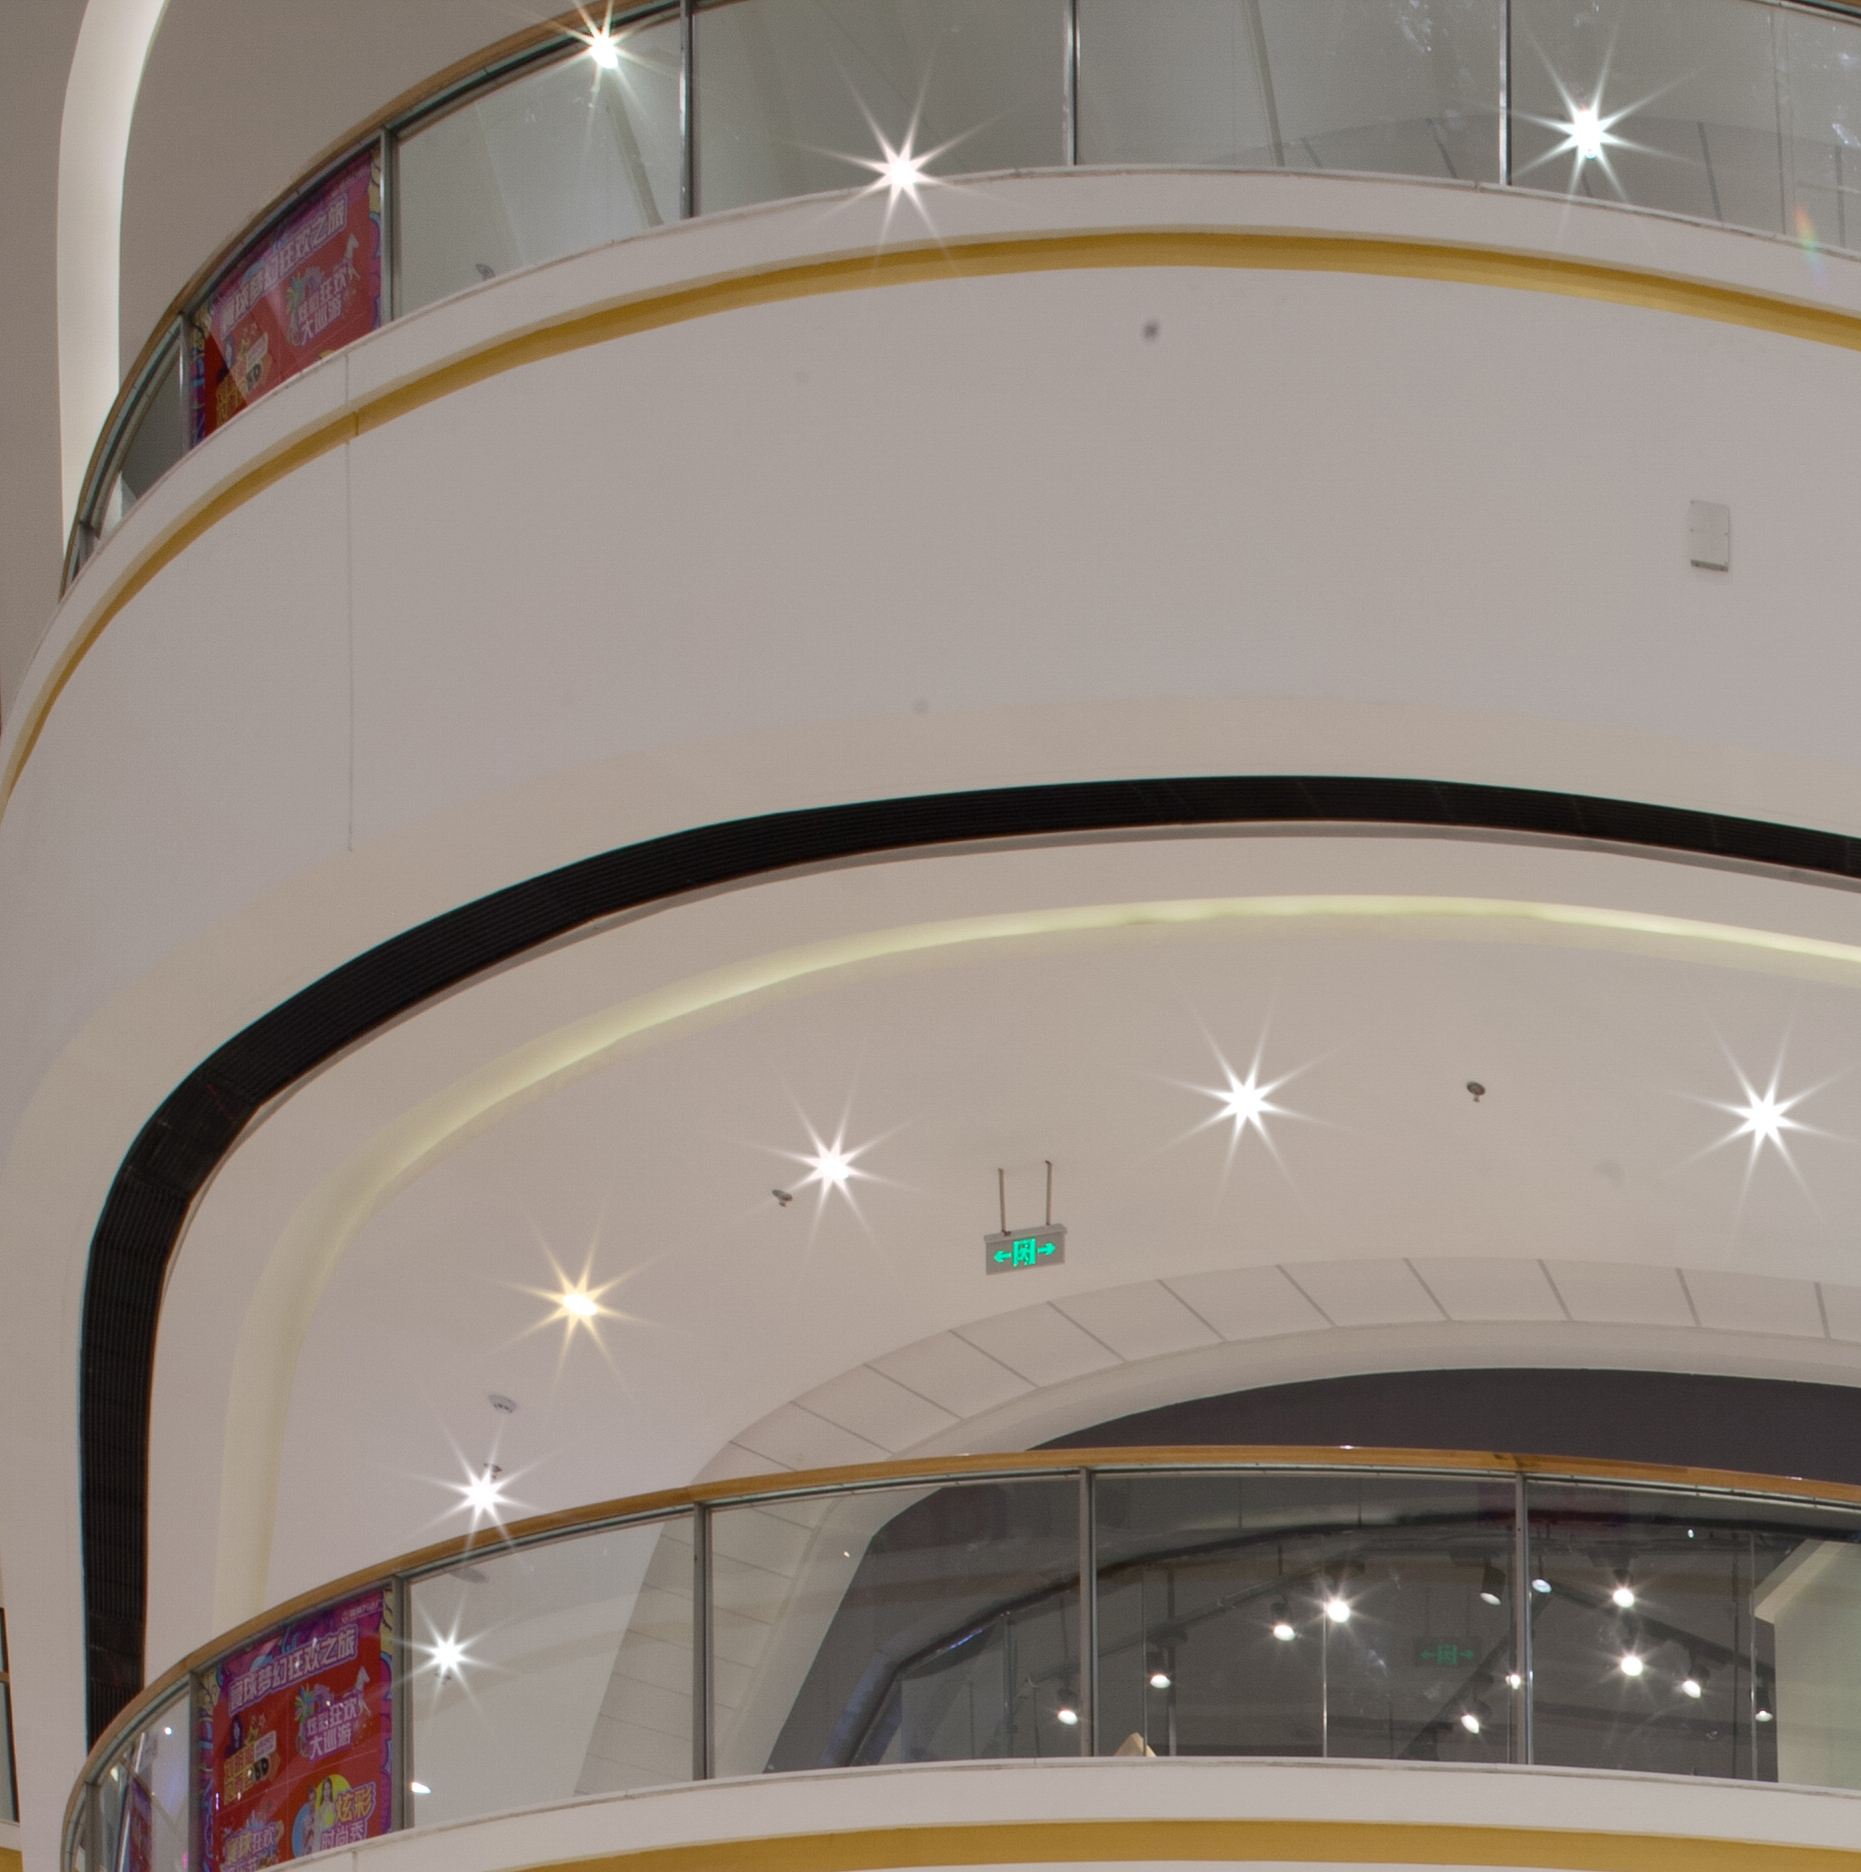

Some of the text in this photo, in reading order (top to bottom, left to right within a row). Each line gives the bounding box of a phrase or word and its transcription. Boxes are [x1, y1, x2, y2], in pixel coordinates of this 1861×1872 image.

[309, 1723, 352, 1760] 大巡游
[336, 1785, 373, 1822] 炫彩
